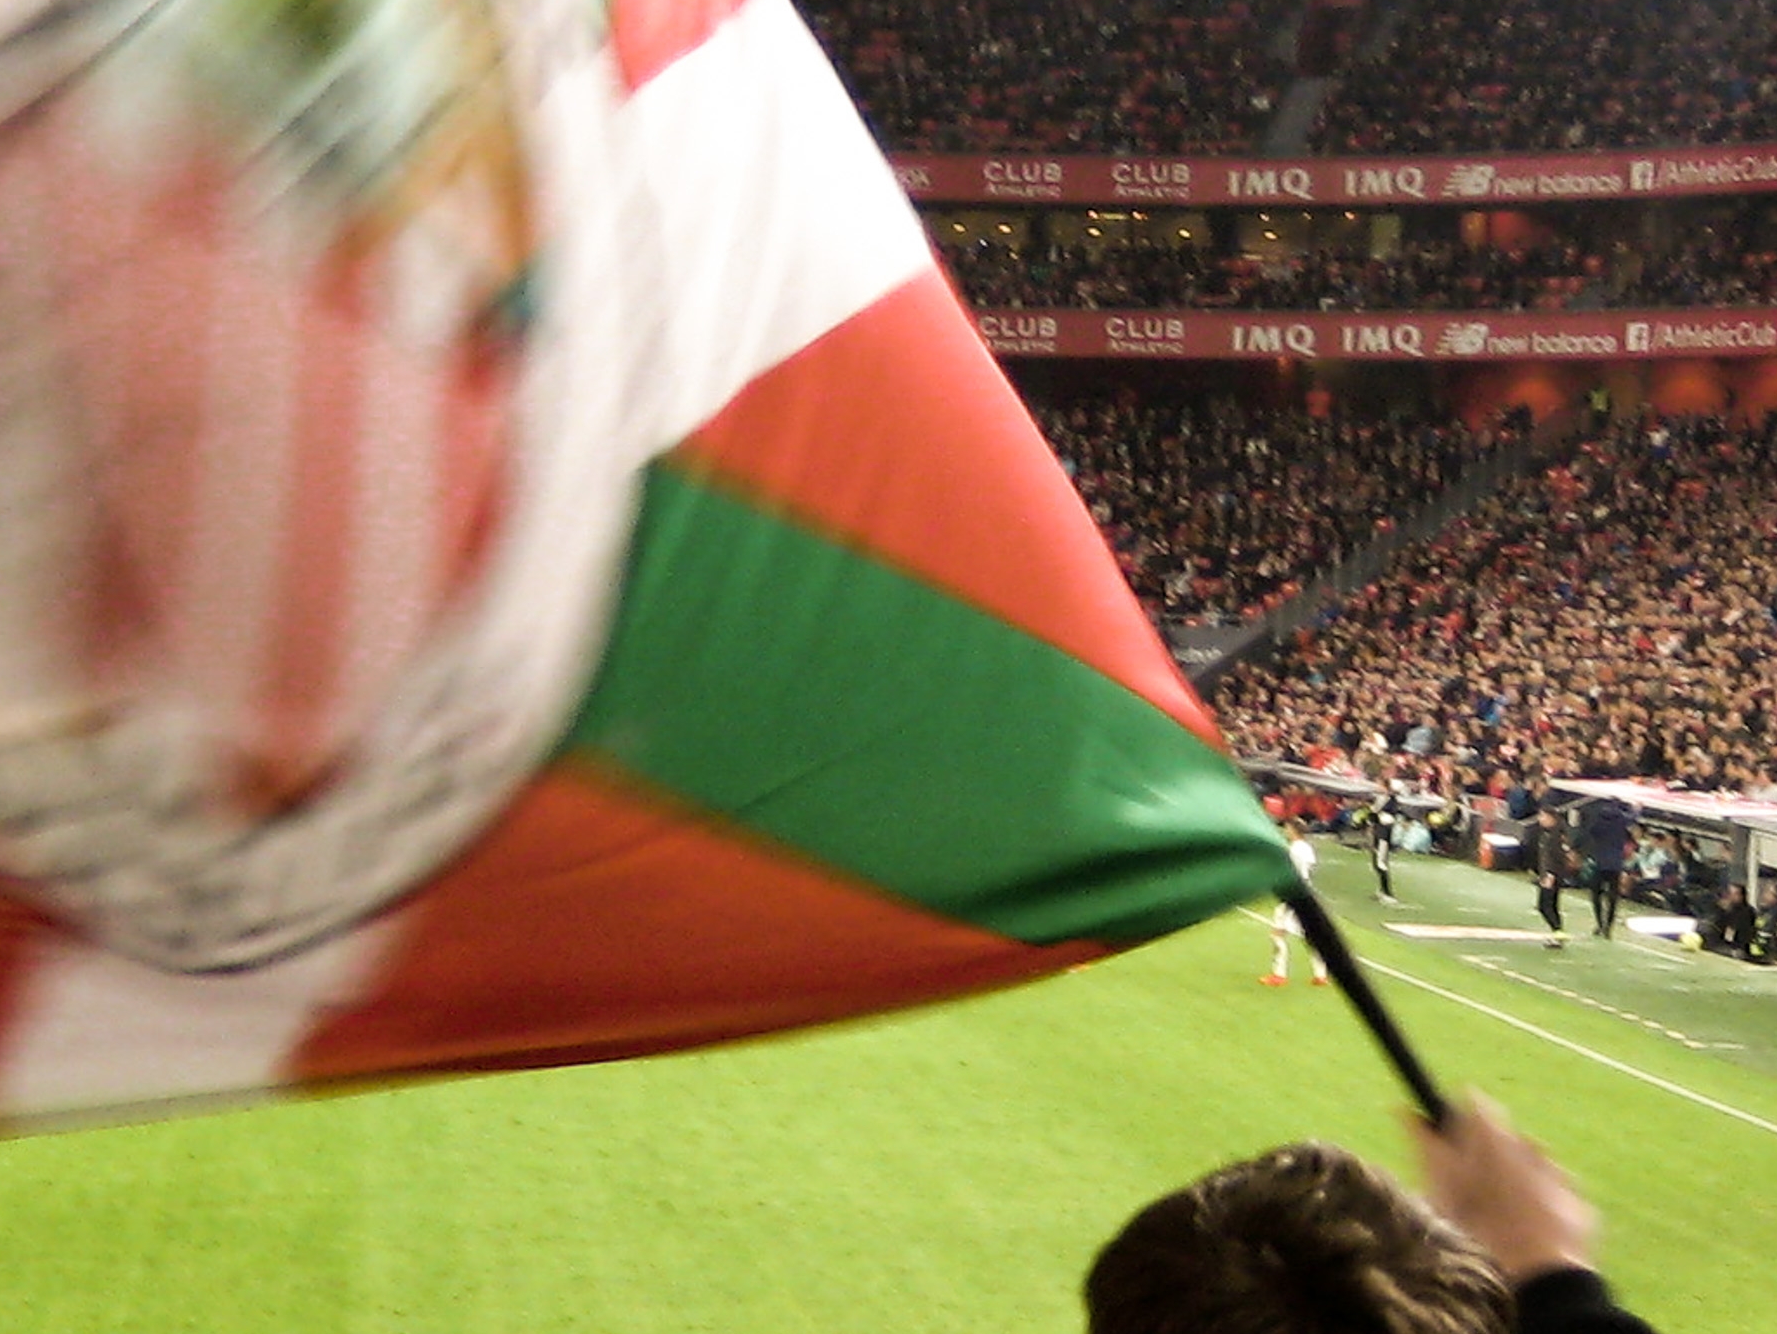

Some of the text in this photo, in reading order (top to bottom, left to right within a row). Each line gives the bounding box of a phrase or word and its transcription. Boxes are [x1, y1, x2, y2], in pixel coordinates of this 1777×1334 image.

[983, 160, 1063, 184] CLUB
[1111, 163, 1191, 185] CLUB
[1226, 168, 1315, 201] IMQ
[1343, 167, 1425, 200] IMQ
[978, 317, 1058, 340] CLUB
[1104, 317, 1185, 340] CLUB
[1231, 323, 1317, 357] IMQ
[1341, 323, 1424, 356] IMQ
